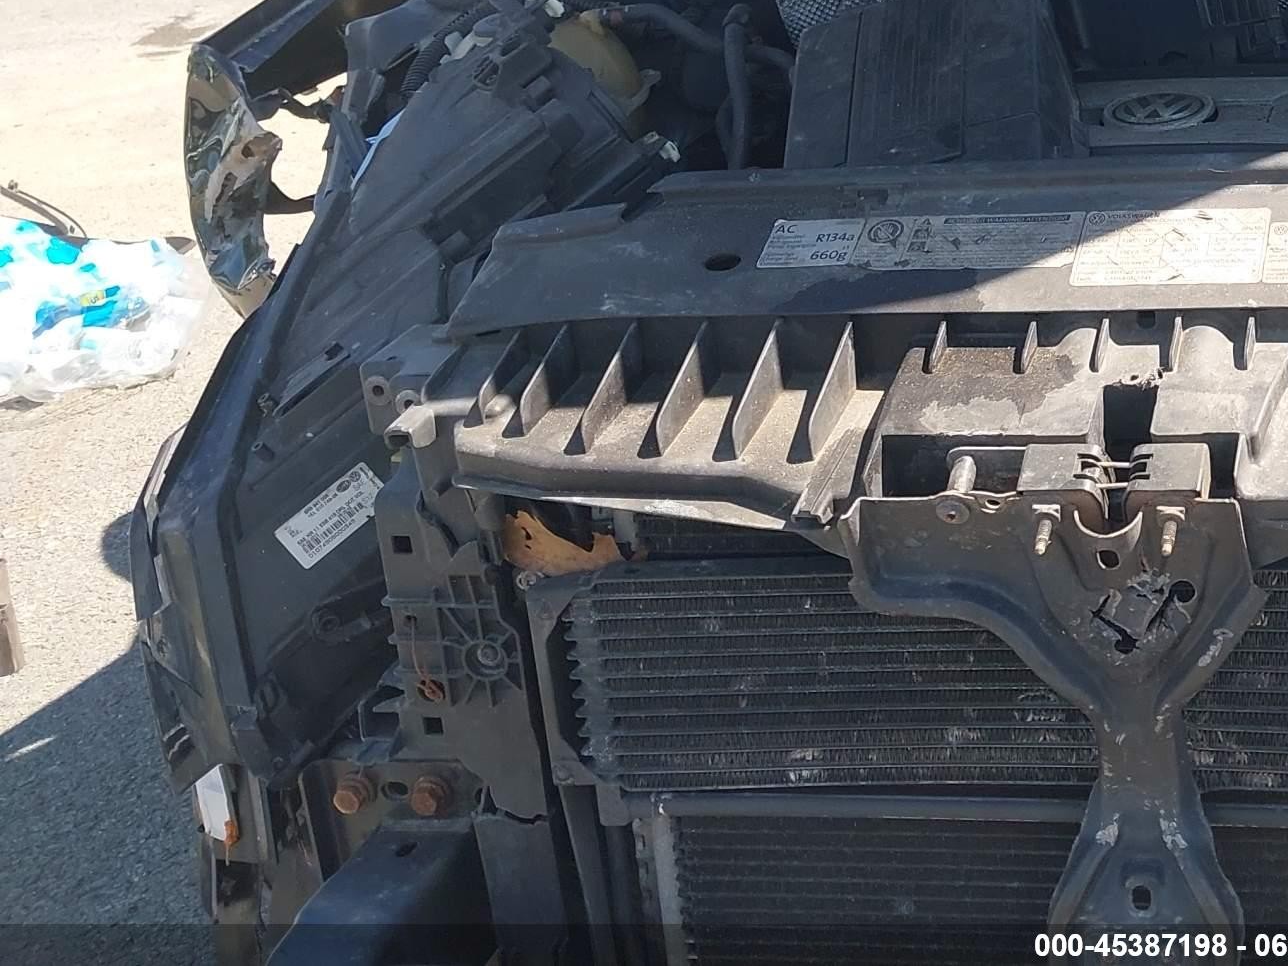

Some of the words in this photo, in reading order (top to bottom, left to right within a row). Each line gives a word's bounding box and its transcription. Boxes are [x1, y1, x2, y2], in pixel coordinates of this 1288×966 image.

[775, 224, 798, 234] AC
[815, 233, 855, 242] R134a
[810, 250, 849, 263] 660g
